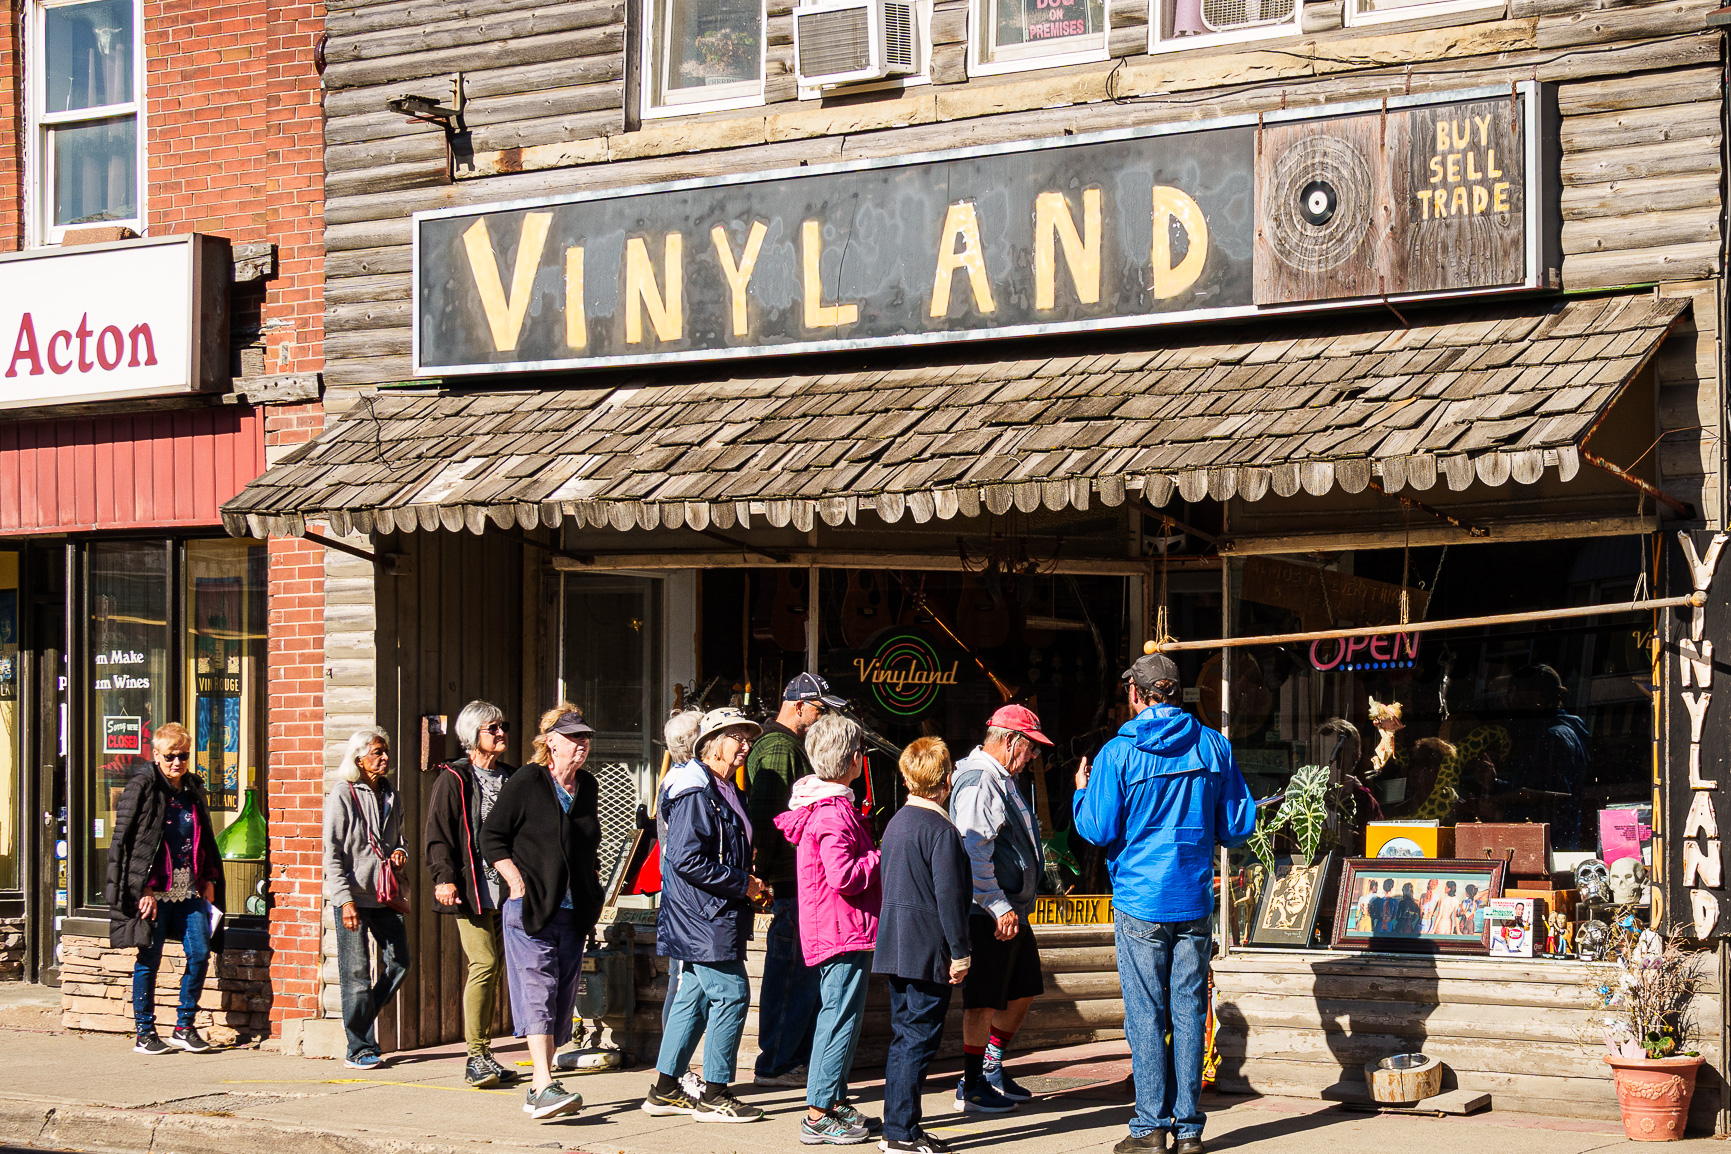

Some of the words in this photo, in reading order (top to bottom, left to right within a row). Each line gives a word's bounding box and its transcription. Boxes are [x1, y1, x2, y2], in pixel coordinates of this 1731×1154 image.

[1029, 19, 1085, 39] PREMISES
[1049, 8, 1063, 20] ON
[1436, 113, 1491, 151] BUY
[1429, 148, 1502, 183] SELL
[1417, 182, 1511, 219] TRADE
[462, 184, 1209, 352] VINYLAND
[5, 311, 158, 378] Acton
[110, 650, 144, 664] Make
[1309, 631, 1420, 671] OPEN
[113, 674, 150, 689] Wines
[214, 677, 240, 692] ROUGE
[853, 658, 959, 692] Vinyland
[107, 735, 139, 748] CLOSED
[1677, 528, 1730, 940] VINYLAND
[211, 792, 238, 808] BLANC
[1036, 898, 1099, 924] HENDRIX
